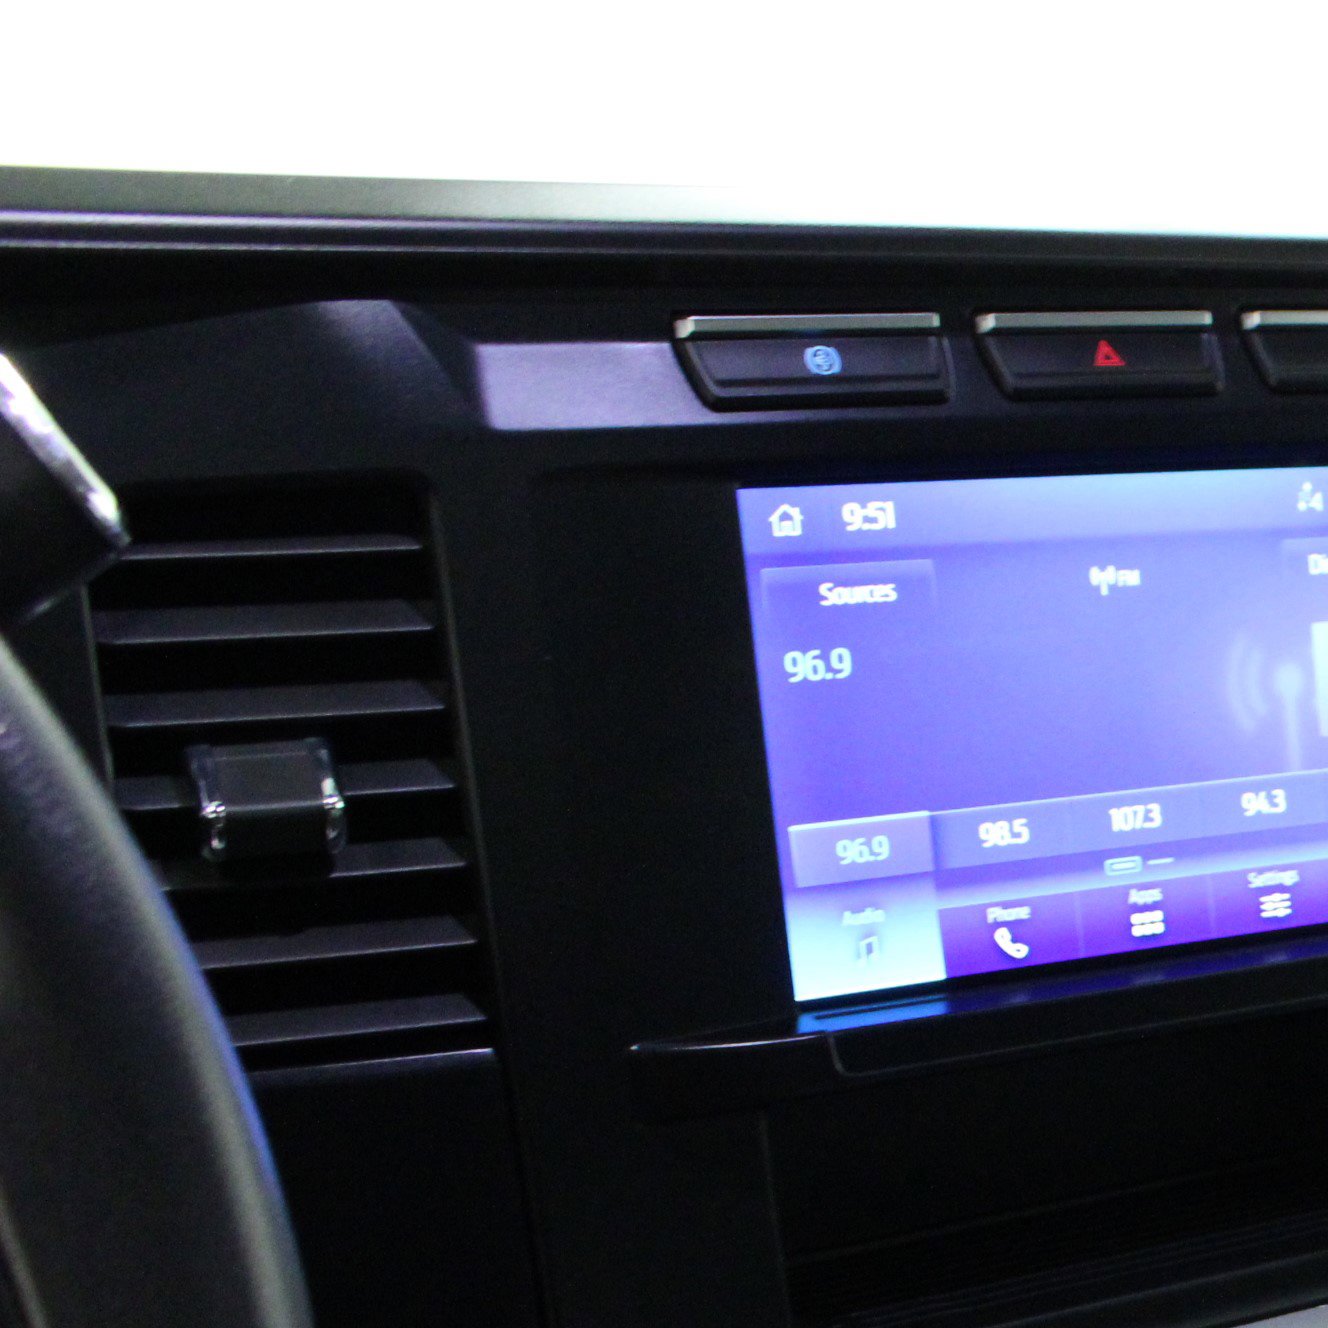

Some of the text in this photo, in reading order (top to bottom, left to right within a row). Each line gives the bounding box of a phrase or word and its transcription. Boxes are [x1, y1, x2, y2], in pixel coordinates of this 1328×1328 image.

[842, 501, 897, 531] 9:51
[819, 582, 898, 606] Sources
[784, 647, 852, 682] 96.9
[1241, 790, 1286, 815] 94.3
[979, 818, 1029, 847] 98.5
[836, 836, 889, 865] 96.9
